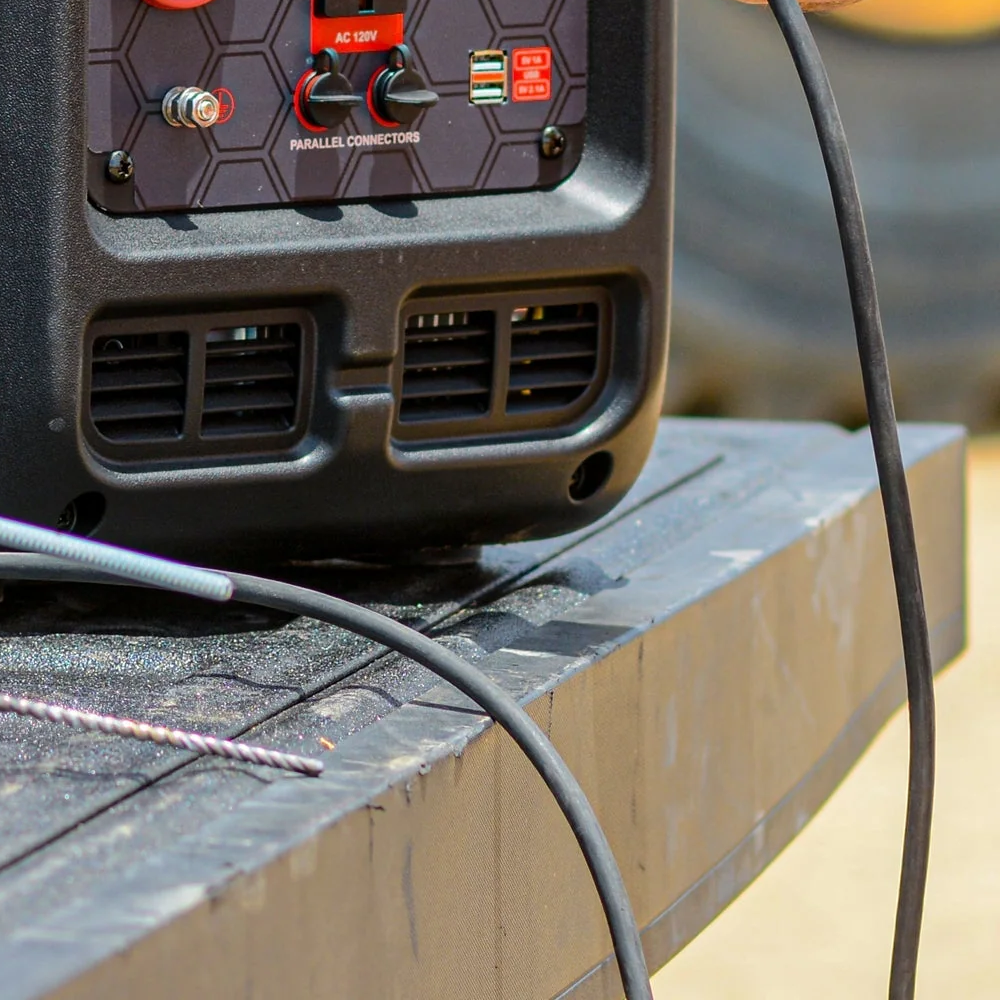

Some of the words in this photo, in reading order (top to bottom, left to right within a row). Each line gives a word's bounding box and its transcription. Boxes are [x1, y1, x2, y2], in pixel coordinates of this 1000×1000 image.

[335, 32, 351, 44] AC
[353, 30, 378, 43] 120V
[290, 135, 345, 151] PARALLEL
[346, 131, 420, 148] CONNECTORS
